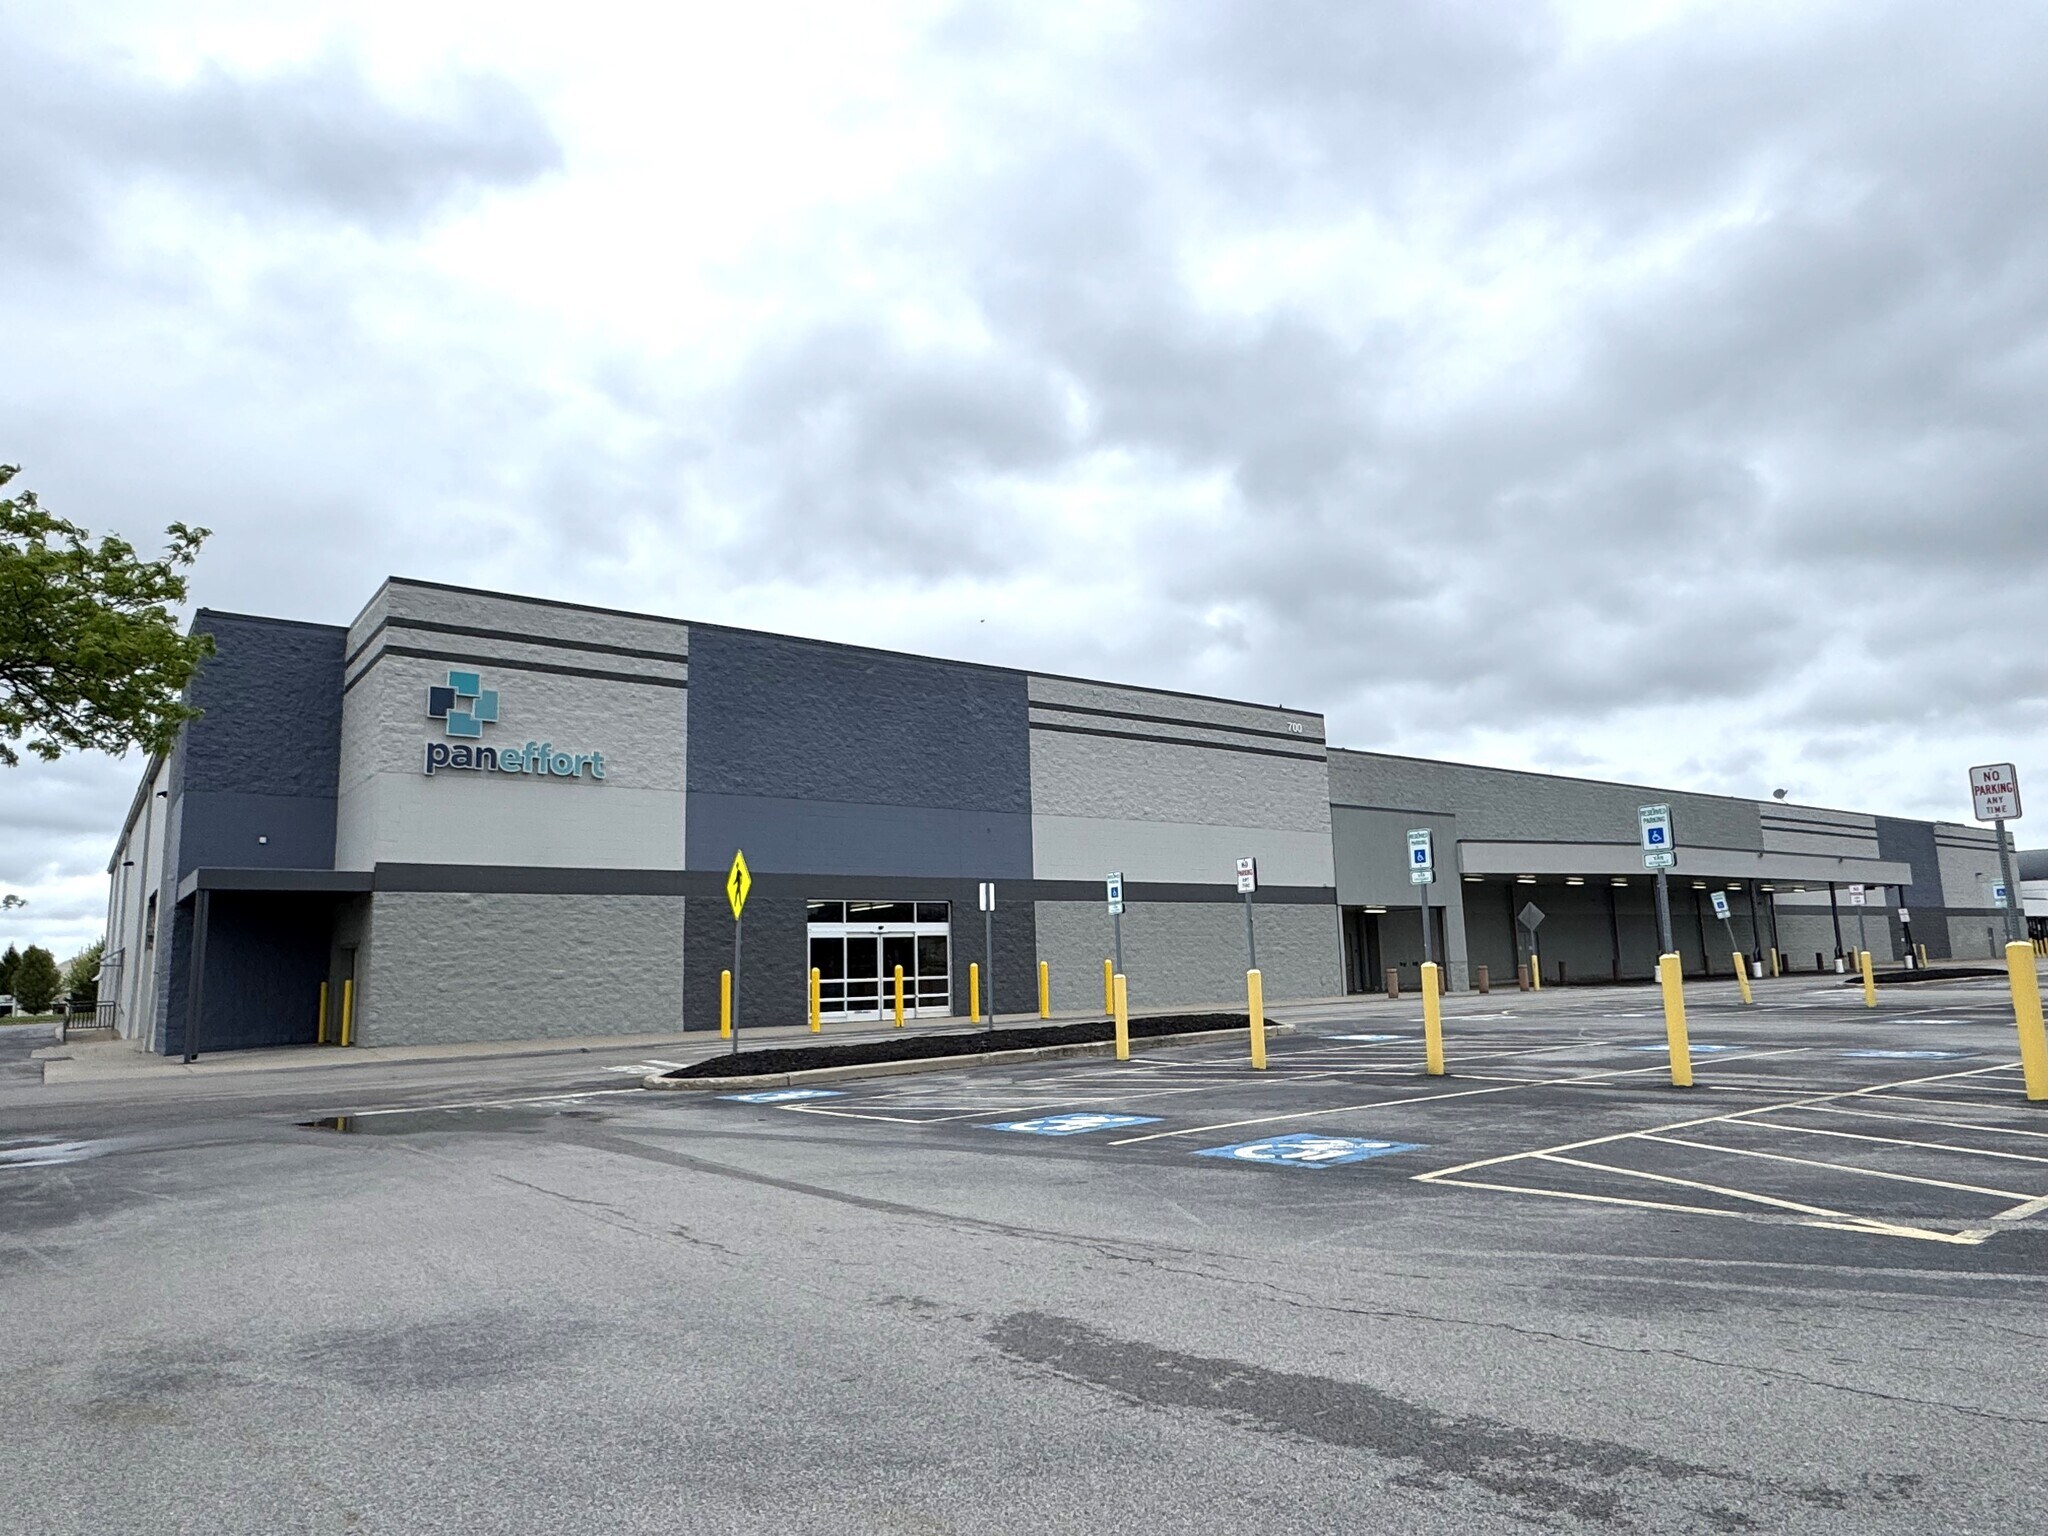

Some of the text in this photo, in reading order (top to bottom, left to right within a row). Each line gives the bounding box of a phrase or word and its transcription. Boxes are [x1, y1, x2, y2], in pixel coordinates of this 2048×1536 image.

[1287, 721, 1303, 733] 700
[424, 740, 606, 779] paneffort
[1983, 770, 2000, 782] NO
[1974, 782, 2013, 796] PARKING
[1986, 796, 2004, 805] ANY
[1986, 804, 2008, 814] TIME
